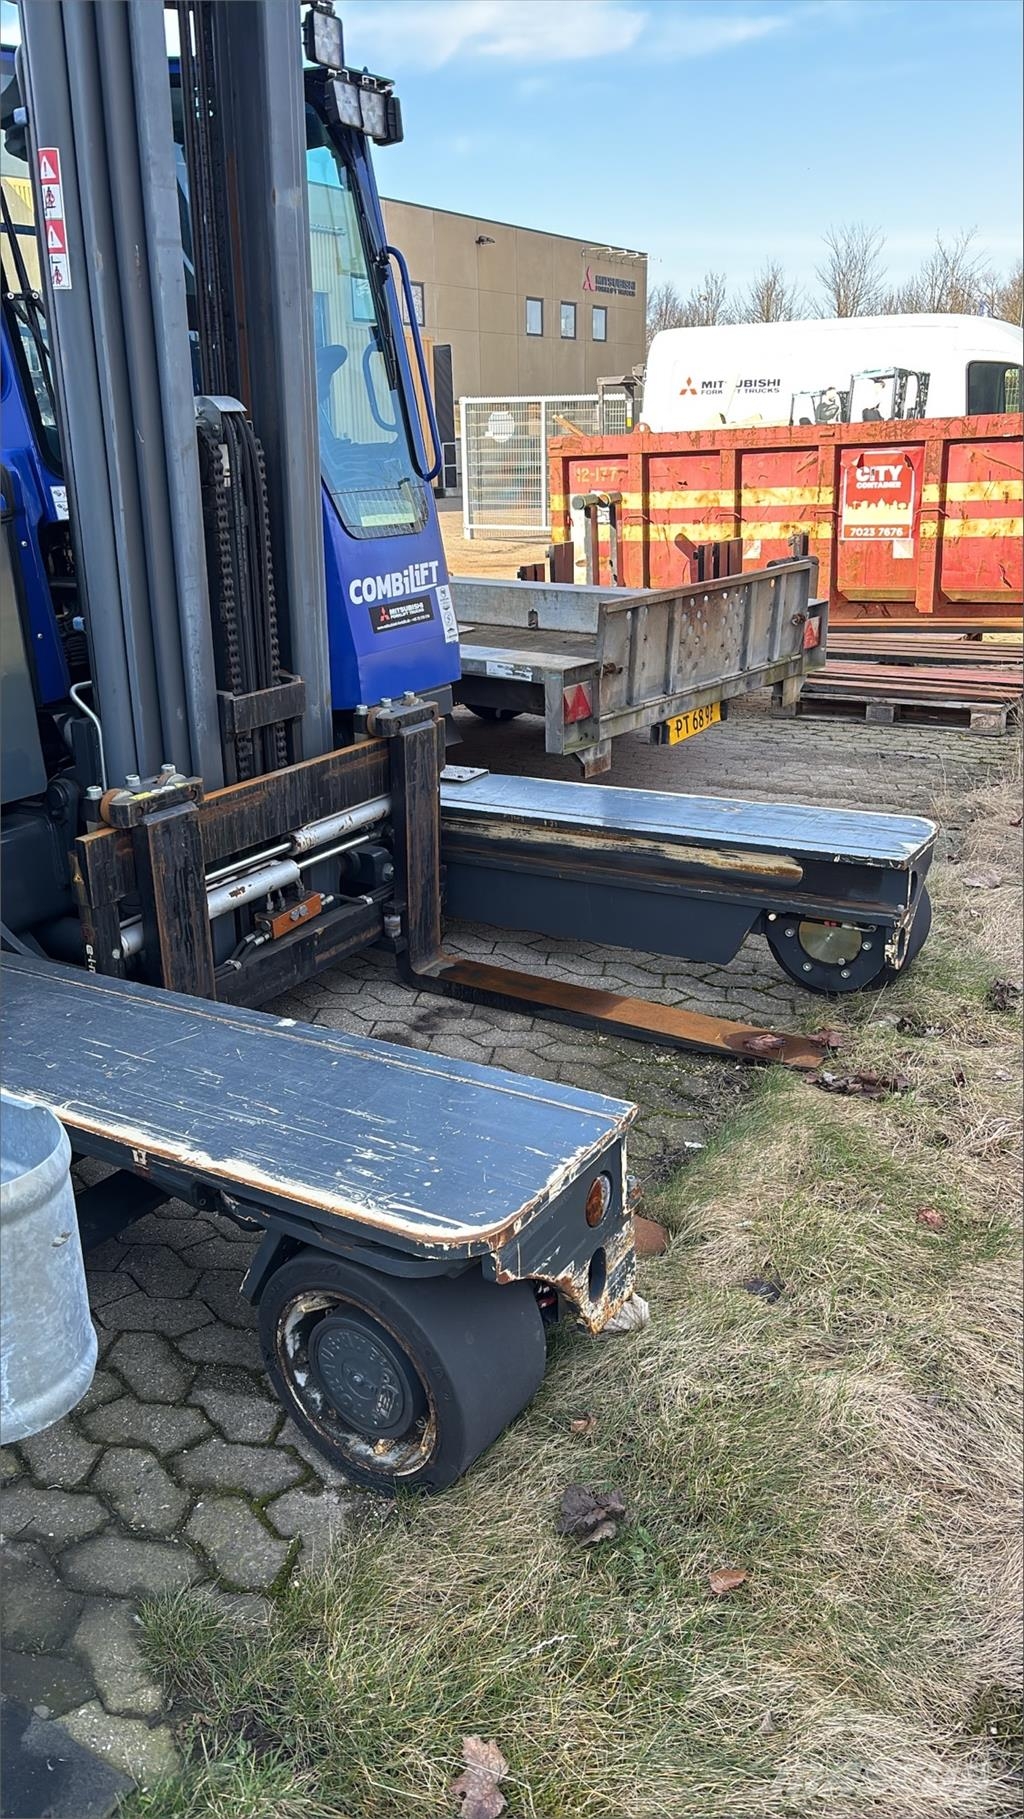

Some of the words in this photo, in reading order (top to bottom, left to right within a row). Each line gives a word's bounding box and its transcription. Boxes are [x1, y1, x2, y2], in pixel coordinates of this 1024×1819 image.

[856, 465, 903, 482] CITY
[856, 481, 902, 489] CONTAINER
[850, 528, 875, 537] 7023
[878, 527, 904, 536] 7676
[676, 715, 689, 738] PT
